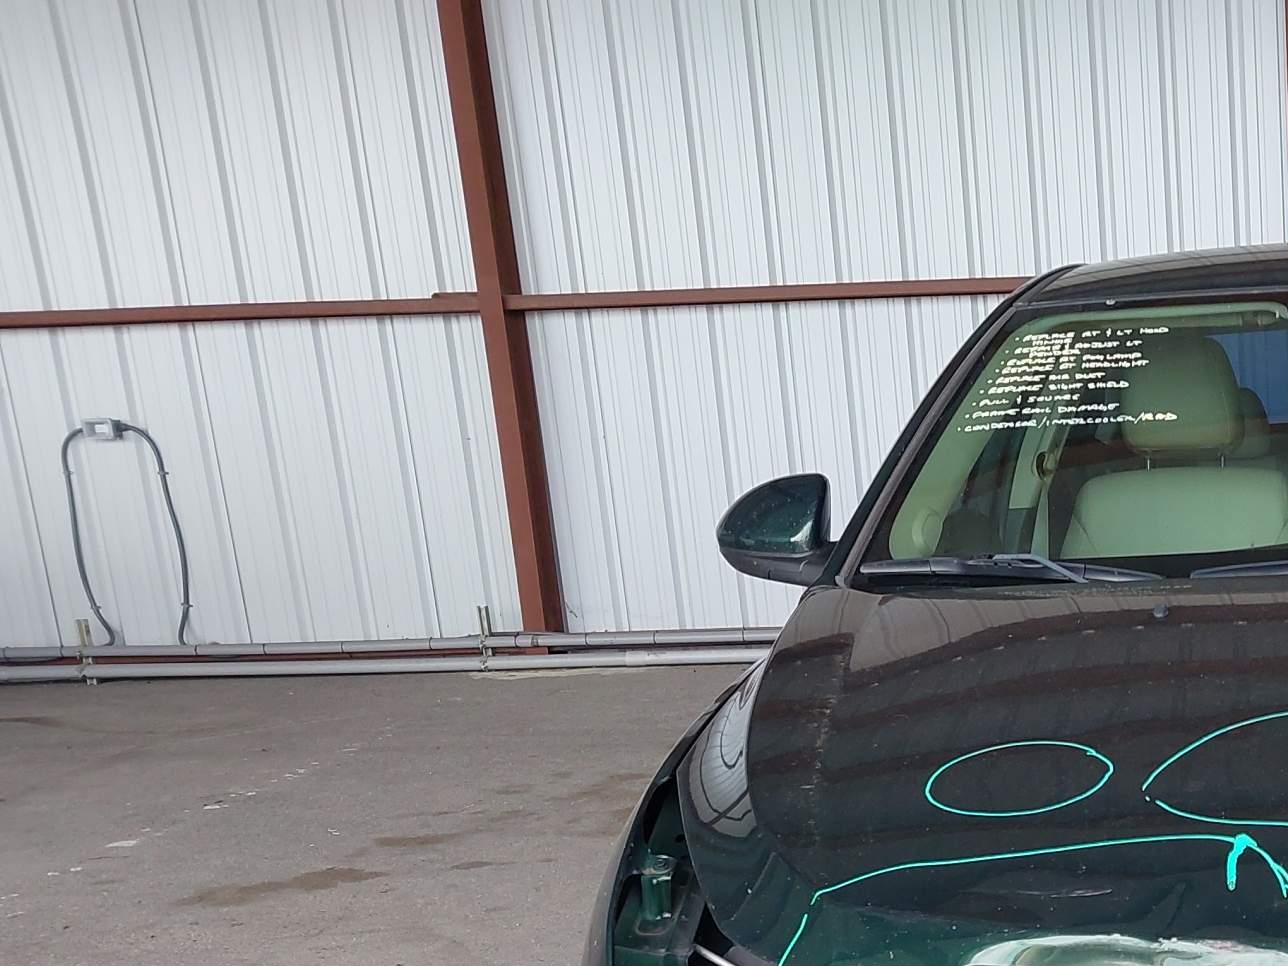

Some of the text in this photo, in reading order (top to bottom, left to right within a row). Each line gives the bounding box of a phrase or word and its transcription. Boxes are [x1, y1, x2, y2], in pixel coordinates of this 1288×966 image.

[1116, 328, 1133, 336] LT
[1105, 351, 1143, 361] LAMP
[1075, 371, 1106, 380] DUCT
[1057, 402, 1120, 414] DAMAGE
